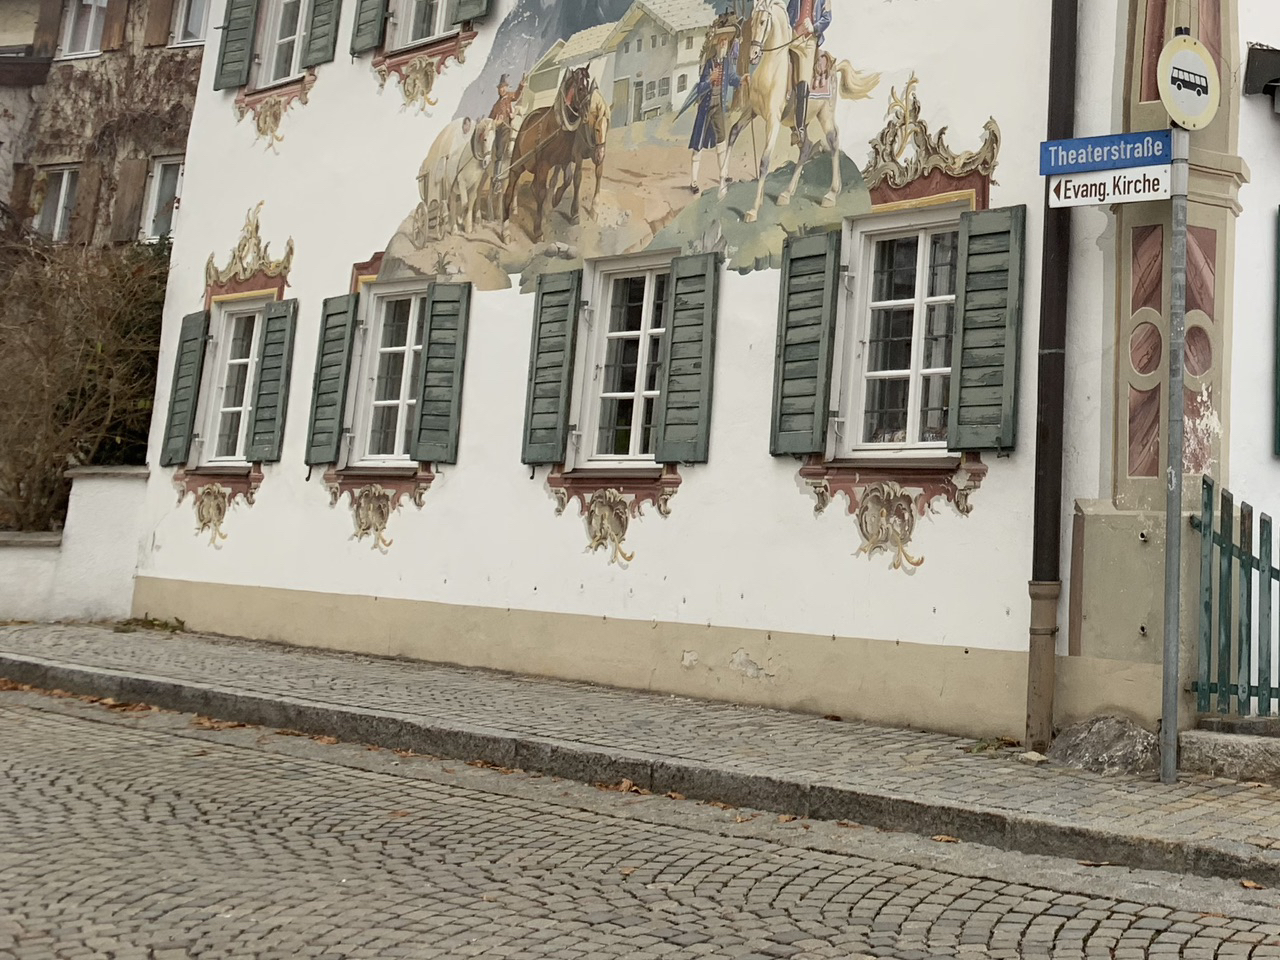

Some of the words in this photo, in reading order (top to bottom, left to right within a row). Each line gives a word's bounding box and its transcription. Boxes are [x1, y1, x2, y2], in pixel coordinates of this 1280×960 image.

[1049, 137, 1163, 167] Theaterstraße
[1063, 179, 1110, 202] Evang.
[1112, 173, 1160, 196] Kirche
